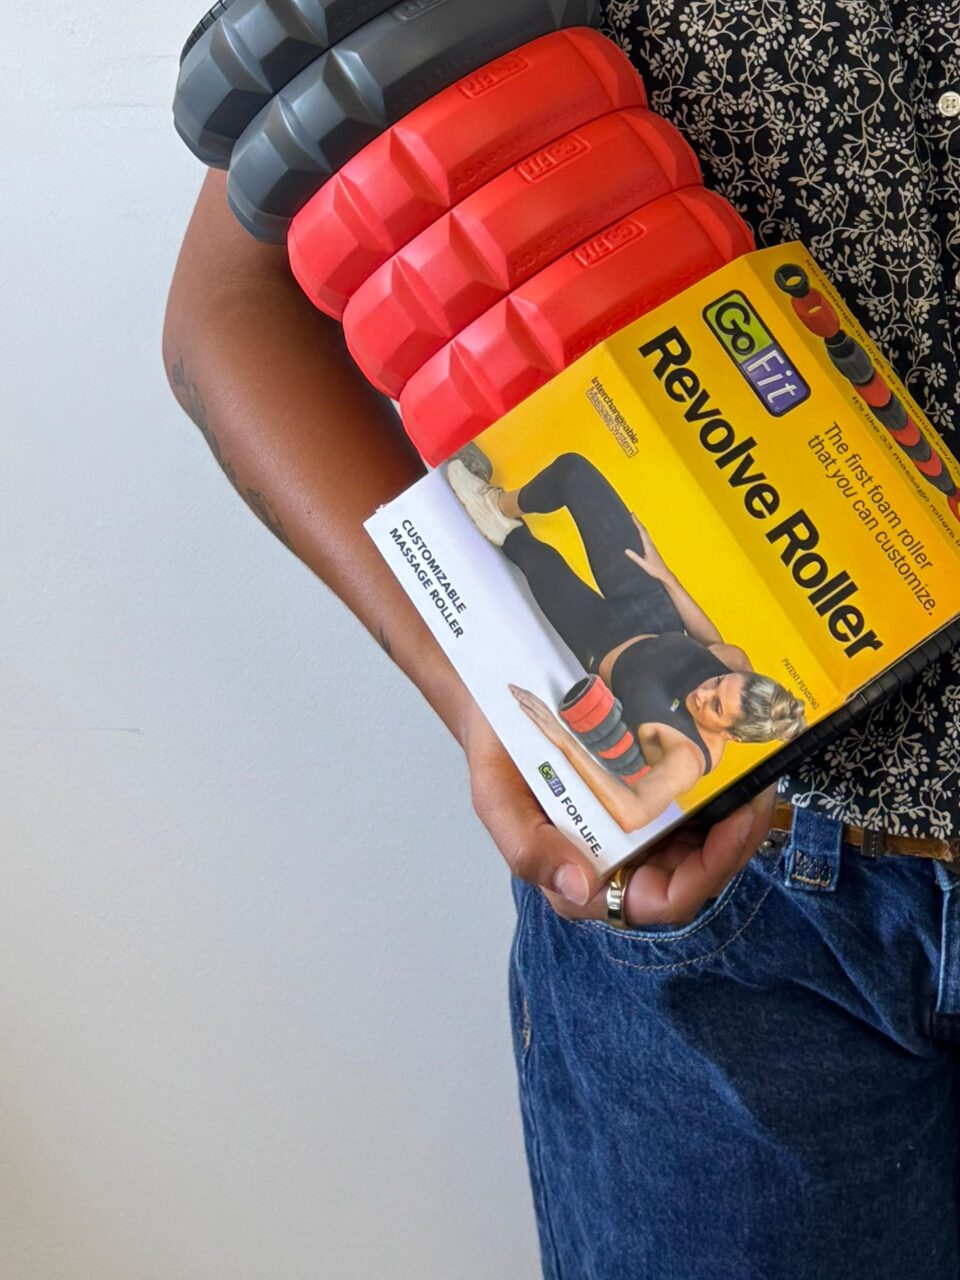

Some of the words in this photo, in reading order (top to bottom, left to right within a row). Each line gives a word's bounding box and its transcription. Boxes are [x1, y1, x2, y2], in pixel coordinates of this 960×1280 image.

[590, 375, 640, 445] Interchangeable
[863, 412, 881, 434] like
[890, 451, 931, 504] massage
[638, 325, 781, 519] Revolve
[766, 508, 884, 659] Roller
[805, 433, 839, 471] that
[825, 465, 858, 502] you
[850, 497, 880, 531] can
[872, 527, 942, 616] customize.
[821, 420, 853, 456] The
[843, 451, 876, 488] first
[865, 482, 905, 529] foam
[896, 525, 936, 572] roller
[388, 527, 434, 590] MASSAGE
[428, 588, 465, 638] ROLLER
[399, 518, 467, 614] CUSTOMIZABLE
[781, 657, 800, 681] PATENT
[796, 680, 820, 710] PENDING
[538, 761, 566, 796] GoFit
[560, 796, 584, 826] FOR
[578, 824, 604, 857] LIFE.
